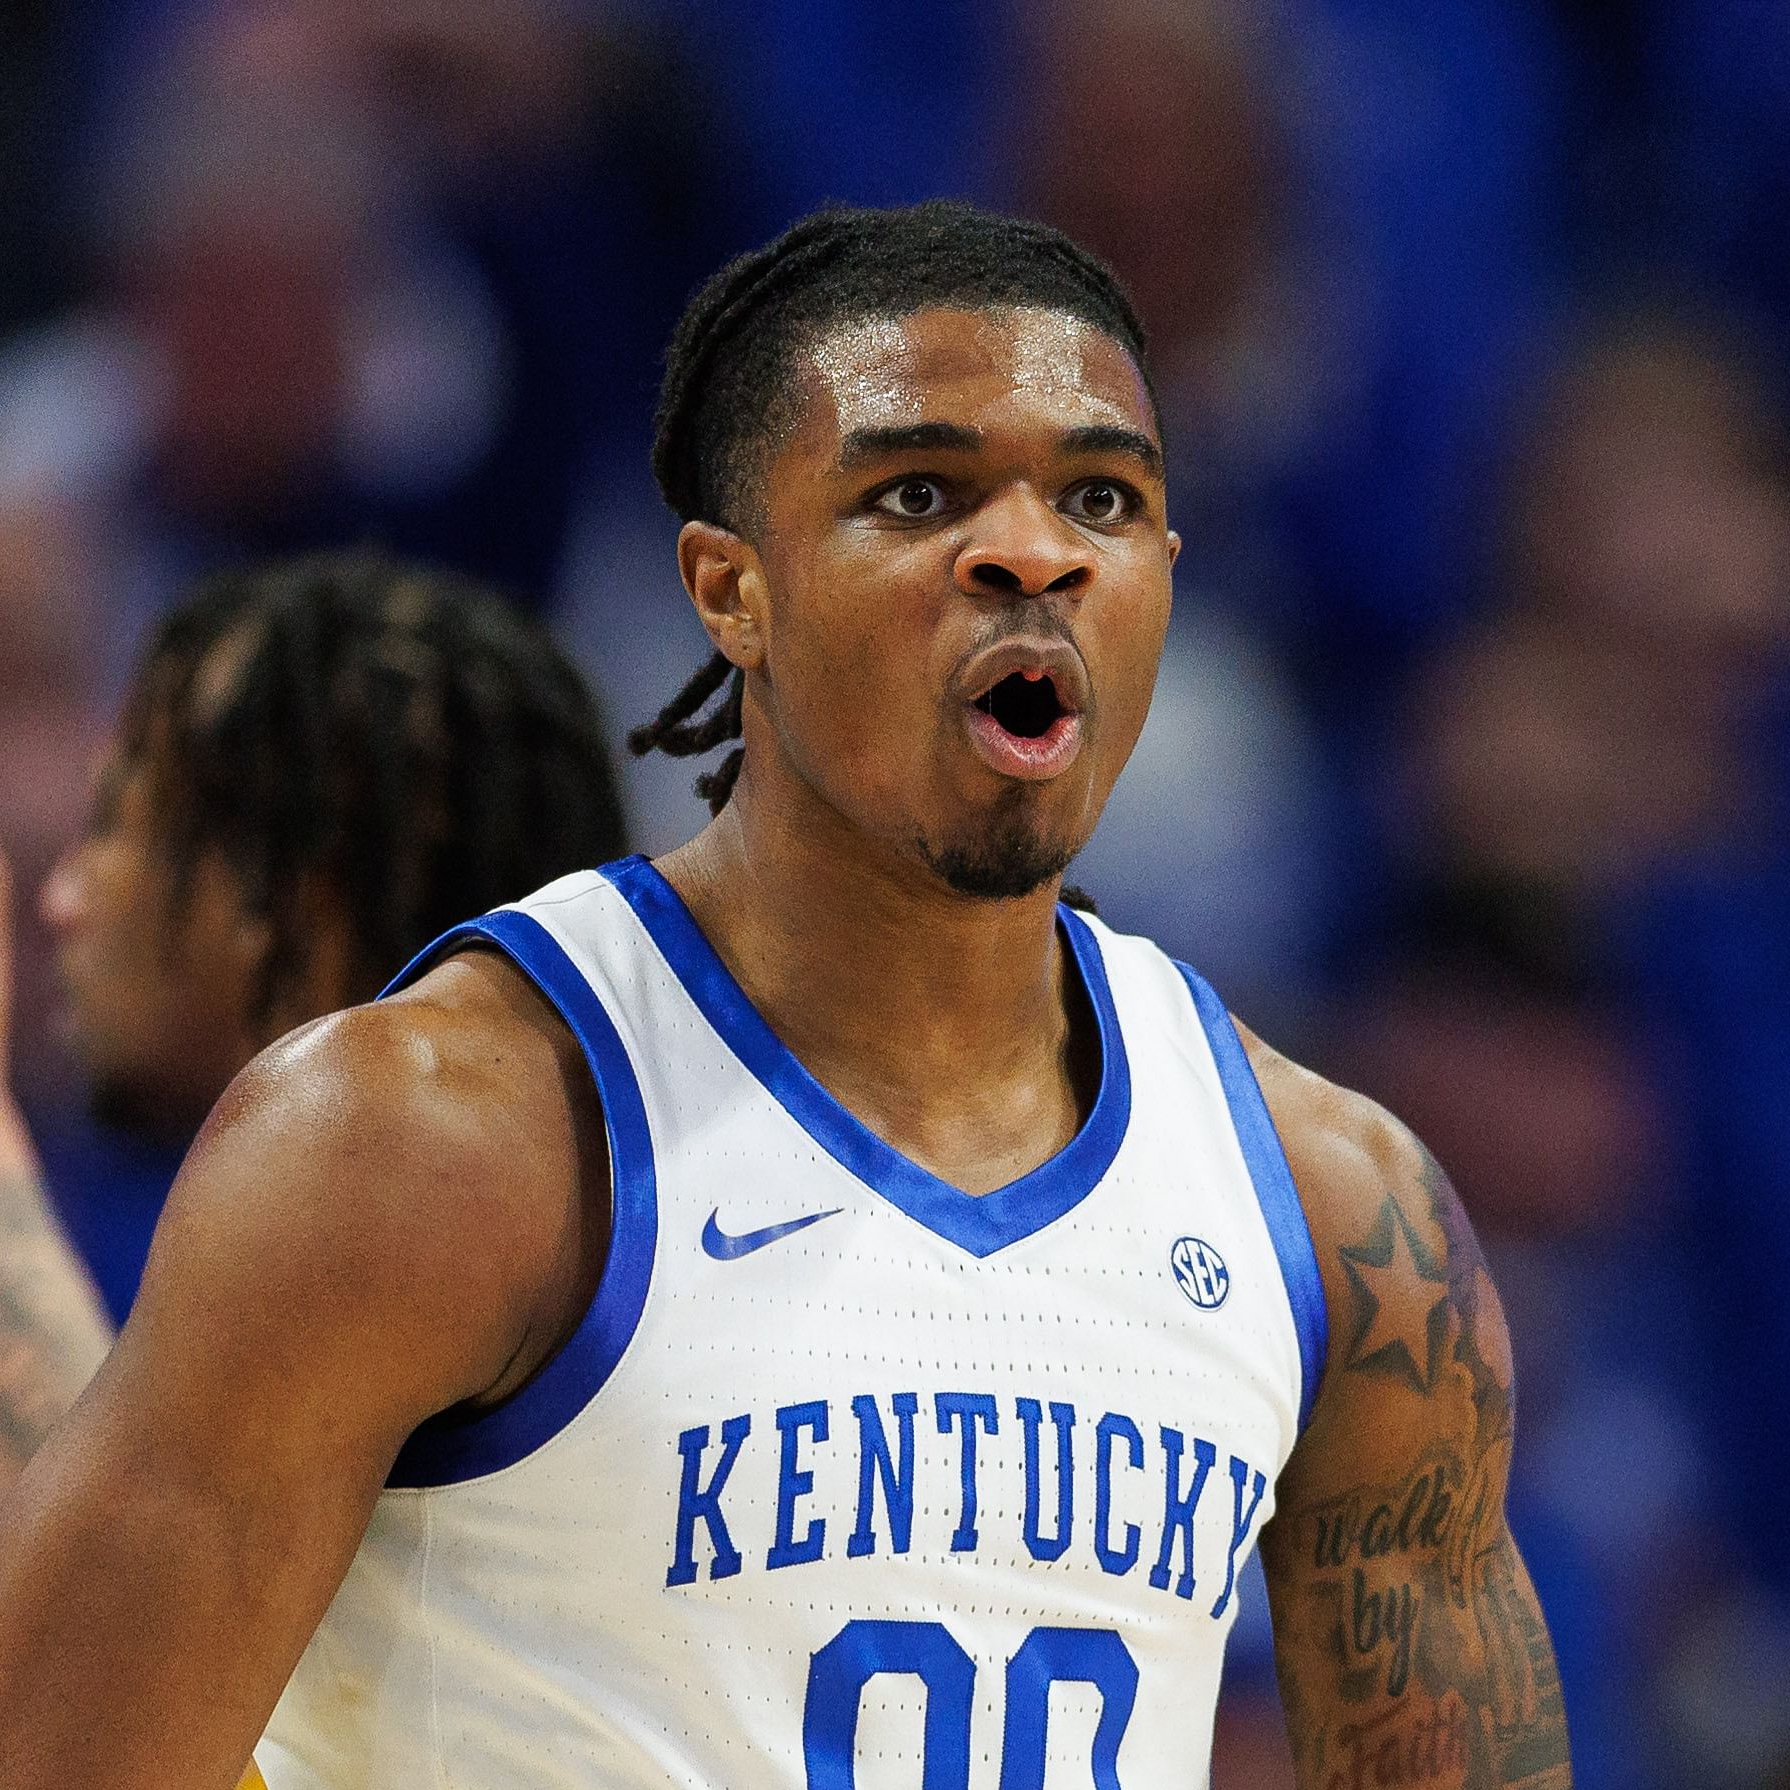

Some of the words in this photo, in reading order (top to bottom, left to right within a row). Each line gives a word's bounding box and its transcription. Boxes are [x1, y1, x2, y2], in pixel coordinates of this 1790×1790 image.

[1172, 1239, 1228, 1305] SEC
[665, 1392, 1267, 1621] KENTUCKY
[1351, 1566, 1418, 1697] by
